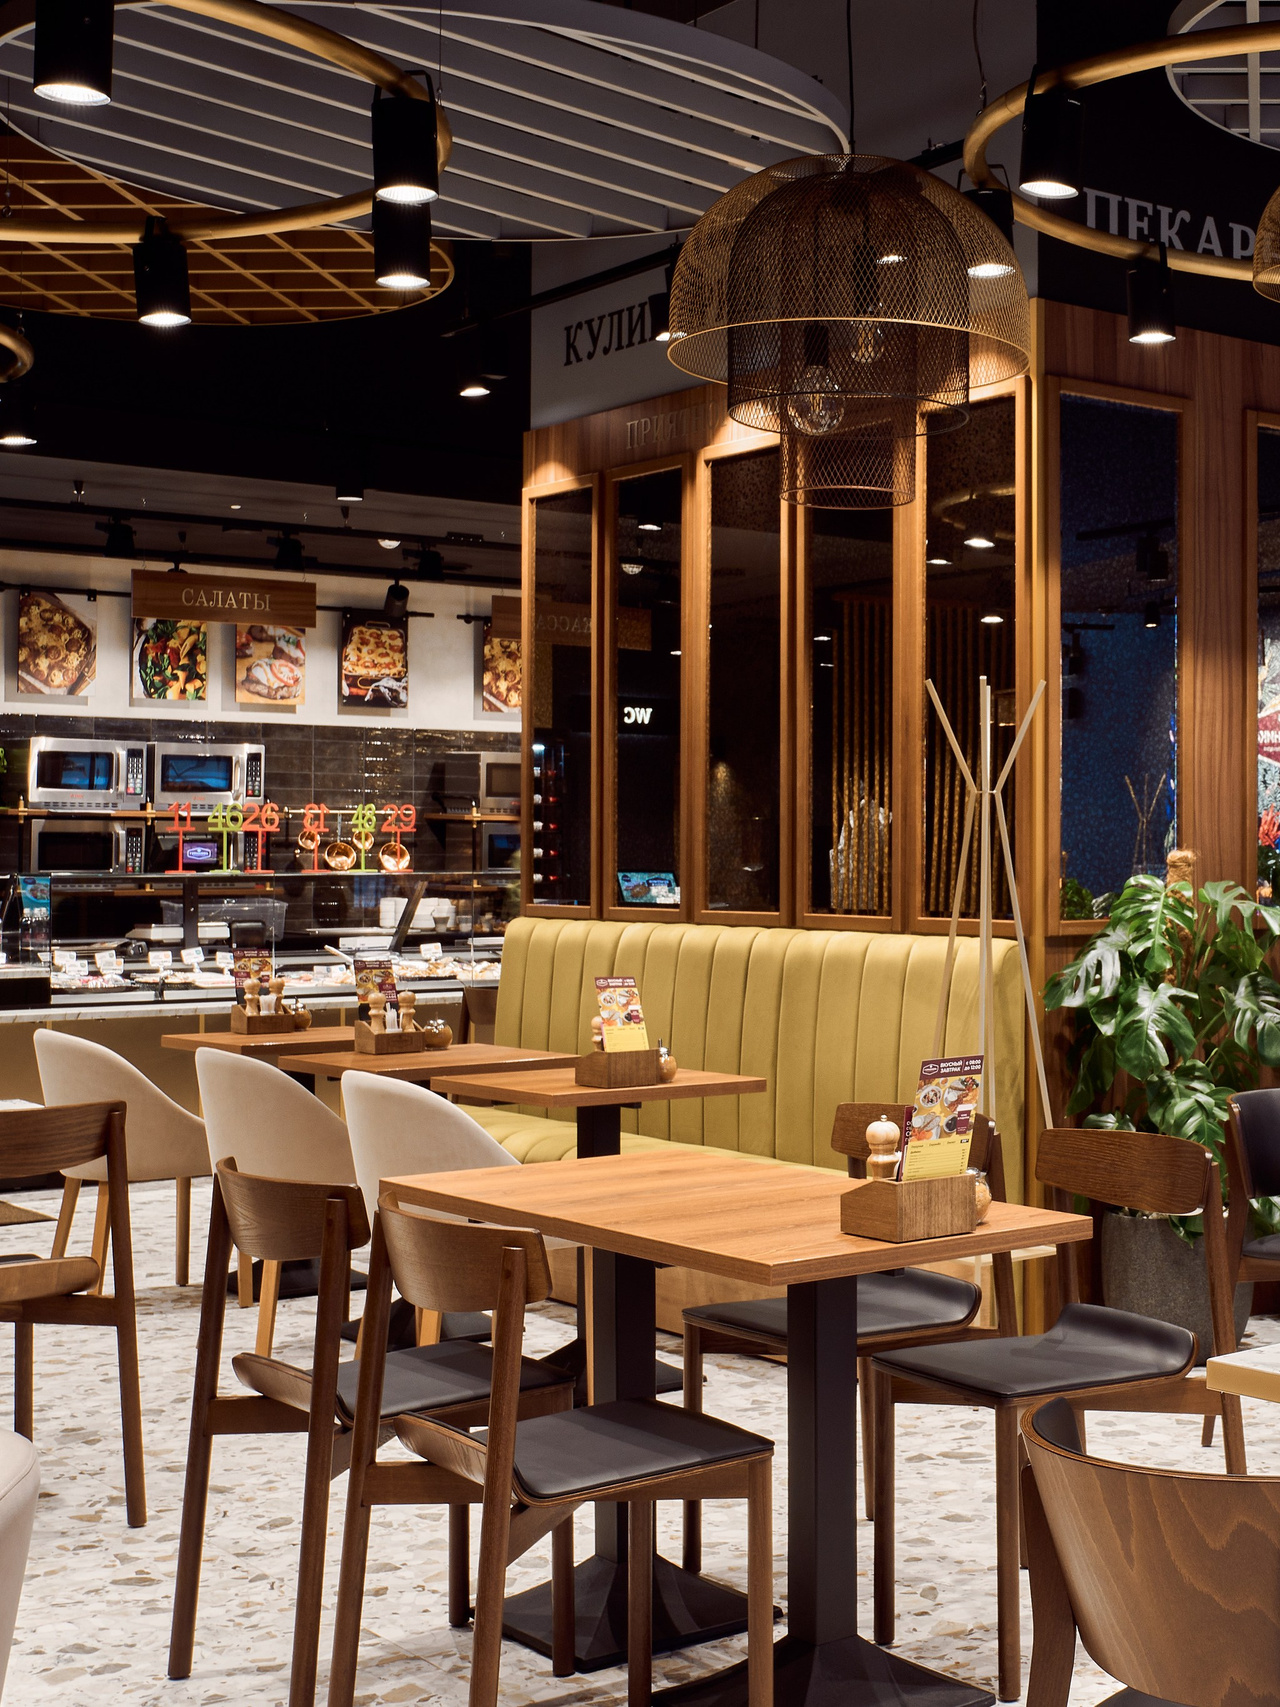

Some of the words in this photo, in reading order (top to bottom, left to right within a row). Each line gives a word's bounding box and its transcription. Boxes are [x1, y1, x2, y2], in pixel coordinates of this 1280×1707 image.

[563, 300, 657, 367] КУЛИ
[181, 587, 273, 612] САЛАТЫ
[208, 802, 243, 829] 46
[243, 802, 280, 829] 26
[382, 803, 416, 828] 29
